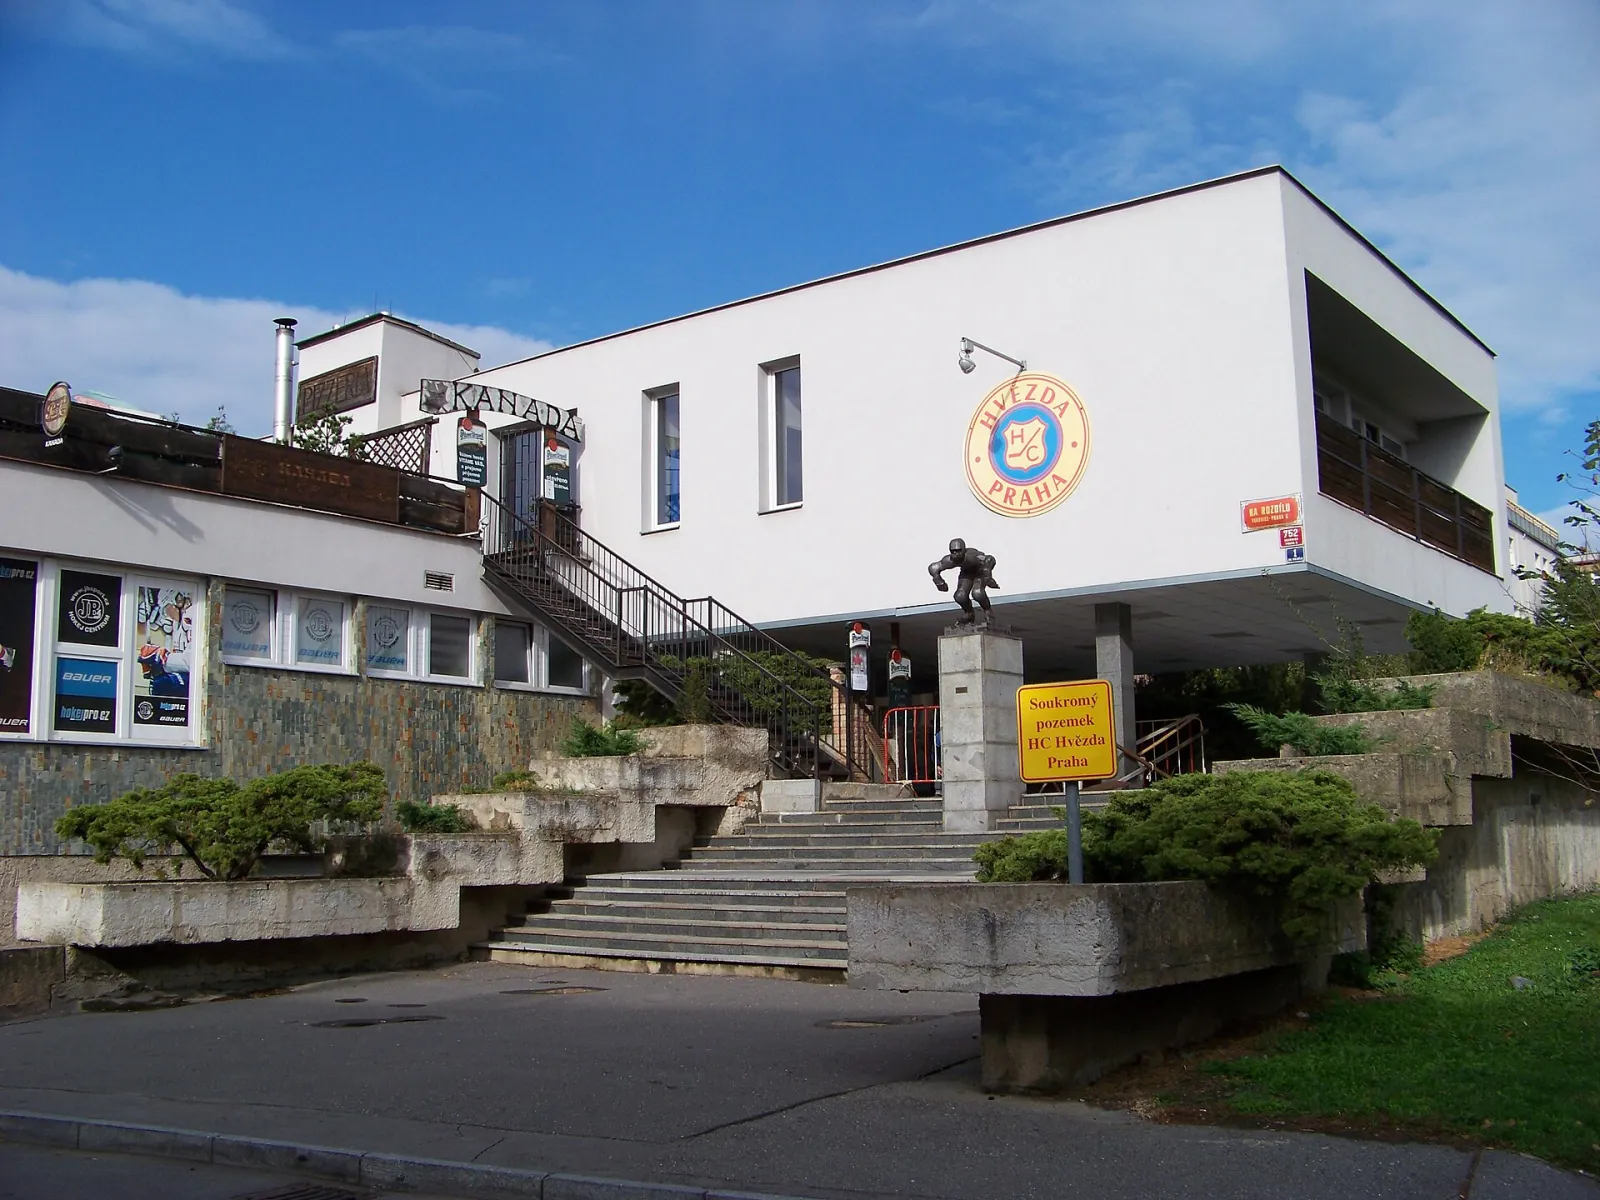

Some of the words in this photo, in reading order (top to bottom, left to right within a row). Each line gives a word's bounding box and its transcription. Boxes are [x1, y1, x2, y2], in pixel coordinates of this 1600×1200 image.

[453, 381, 582, 443] KANADA
[980, 383, 1069, 429] HVĚZDA
[988, 473, 1068, 507] PRAHA
[1249, 507, 1258, 517] NA
[1261, 502, 1291, 515] ROZDÍLU
[68, 611, 85, 631] HOKEJ
[84, 614, 111, 633] CENTRUM
[298, 648, 340, 659] BAUER
[62, 671, 112, 685] BAUER
[1029, 692, 1098, 710] Soukromý
[1036, 714, 1095, 732] pozemek
[1028, 737, 1051, 750] HC
[1056, 733, 1105, 748] Hvězda
[1047, 755, 1088, 769] Praha
